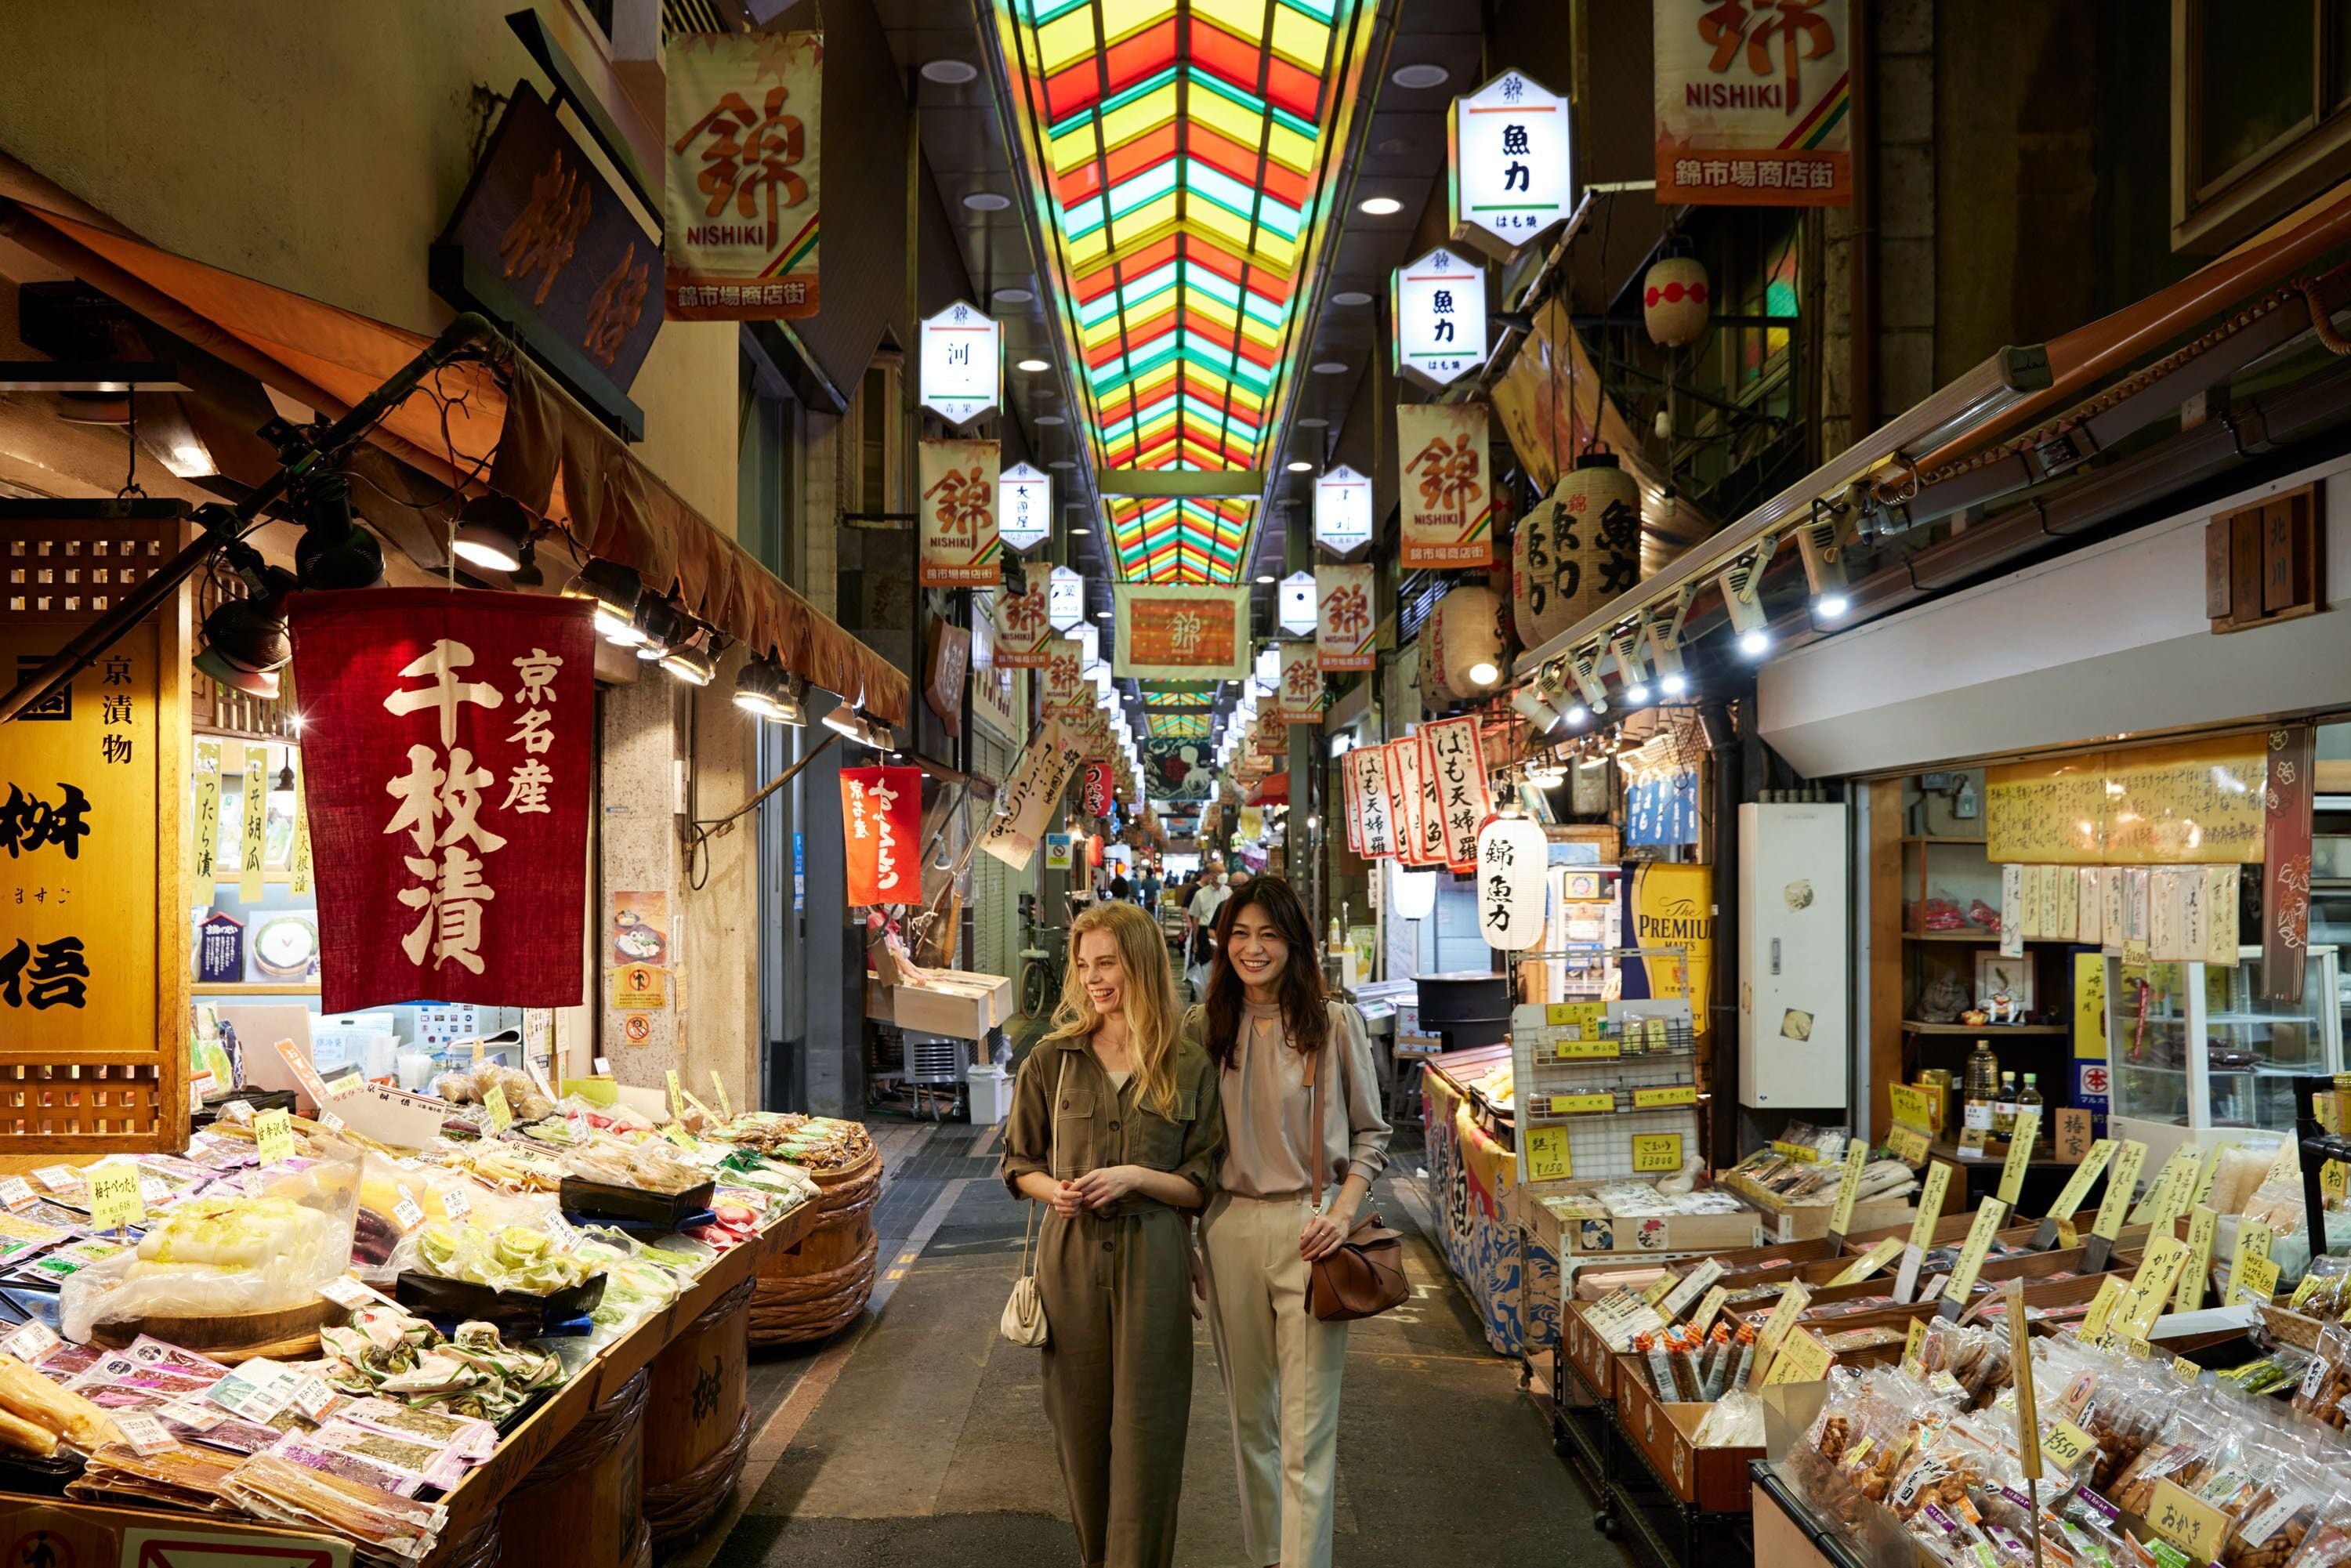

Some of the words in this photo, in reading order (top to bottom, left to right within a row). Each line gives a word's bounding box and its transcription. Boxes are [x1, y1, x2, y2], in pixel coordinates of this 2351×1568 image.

[1686, 84, 1780, 109] NISHIKI
[674, 86, 809, 253] 錦
[1501, 124, 1531, 193] 魚力
[1675, 161, 1833, 189] 錦市場商店街
[687, 226, 763, 246] NISHIKI
[678, 283, 805, 308] 錦市場商店街
[1433, 289, 1455, 343] 魚力
[1405, 433, 1483, 528] 錦
[924, 465, 994, 551] 錦
[1414, 513, 1458, 527] NISHIKI
[930, 536, 970, 548] NISHIKI
[1411, 547, 1484, 561] 錦市場商店街
[926, 567, 993, 581] 錦市場商店街
[1319, 582, 1370, 643] 錦
[1001, 632, 1031, 642] NISHIKI
[1324, 635, 1356, 644] NISHIKI
[1046, 654, 1080, 700] 錦
[1281, 657, 1318, 704] 錦
[101, 654, 133, 765] 京漬物
[498, 647, 563, 815] 京名産
[382, 638, 507, 976] 千枚漬
[1085, 765, 1103, 816] うなぎ
[1358, 756, 1388, 856] はも天婦羅
[1436, 730, 1480, 863] はも天婦羅
[197, 759, 216, 878] ったら漬
[245, 763, 262, 872] しそ胡瓜
[15, 886, 71, 904] ますご
[1485, 838, 1515, 932] 錦魚力
[1639, 914, 1712, 940] PREMIU
[1657, 896, 1702, 917] The
[2063, 1114, 2085, 1157] 椿家
[1536, 1161, 1563, 1175] ¥150
[1642, 1155, 1673, 1168] ¥3000
[95, 1176, 136, 1200] 柚子べったら
[2162, 1250, 2183, 1285] 伊賀
[2041, 1427, 2079, 1459] ¥550
[2160, 1504, 2201, 1545] おかき
